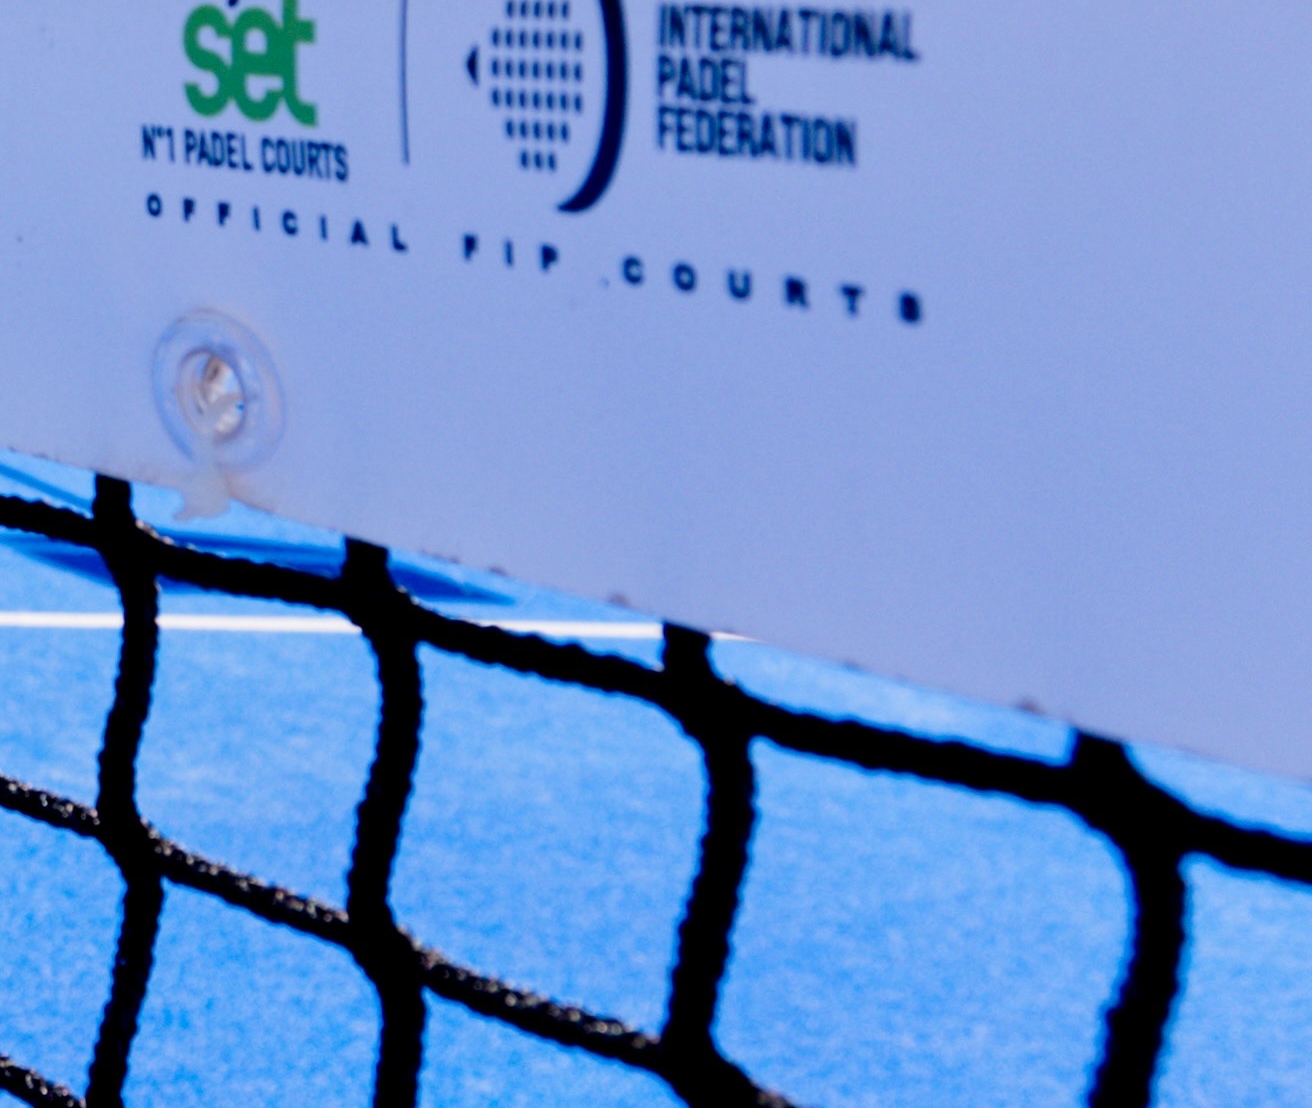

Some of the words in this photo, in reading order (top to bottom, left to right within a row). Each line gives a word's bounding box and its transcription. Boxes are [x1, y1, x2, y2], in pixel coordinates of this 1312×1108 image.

[657, 1, 921, 62] INTERNATIONAL
[656, 53, 757, 105] PADEL
[184, 128, 253, 171] PADEL
[261, 136, 349, 182] COURTS
[656, 105, 858, 168] FEDERATION
[146, 194, 409, 253] OFFICIAL
[462, 233, 559, 272] FIP
[622, 255, 922, 324] COURTS
